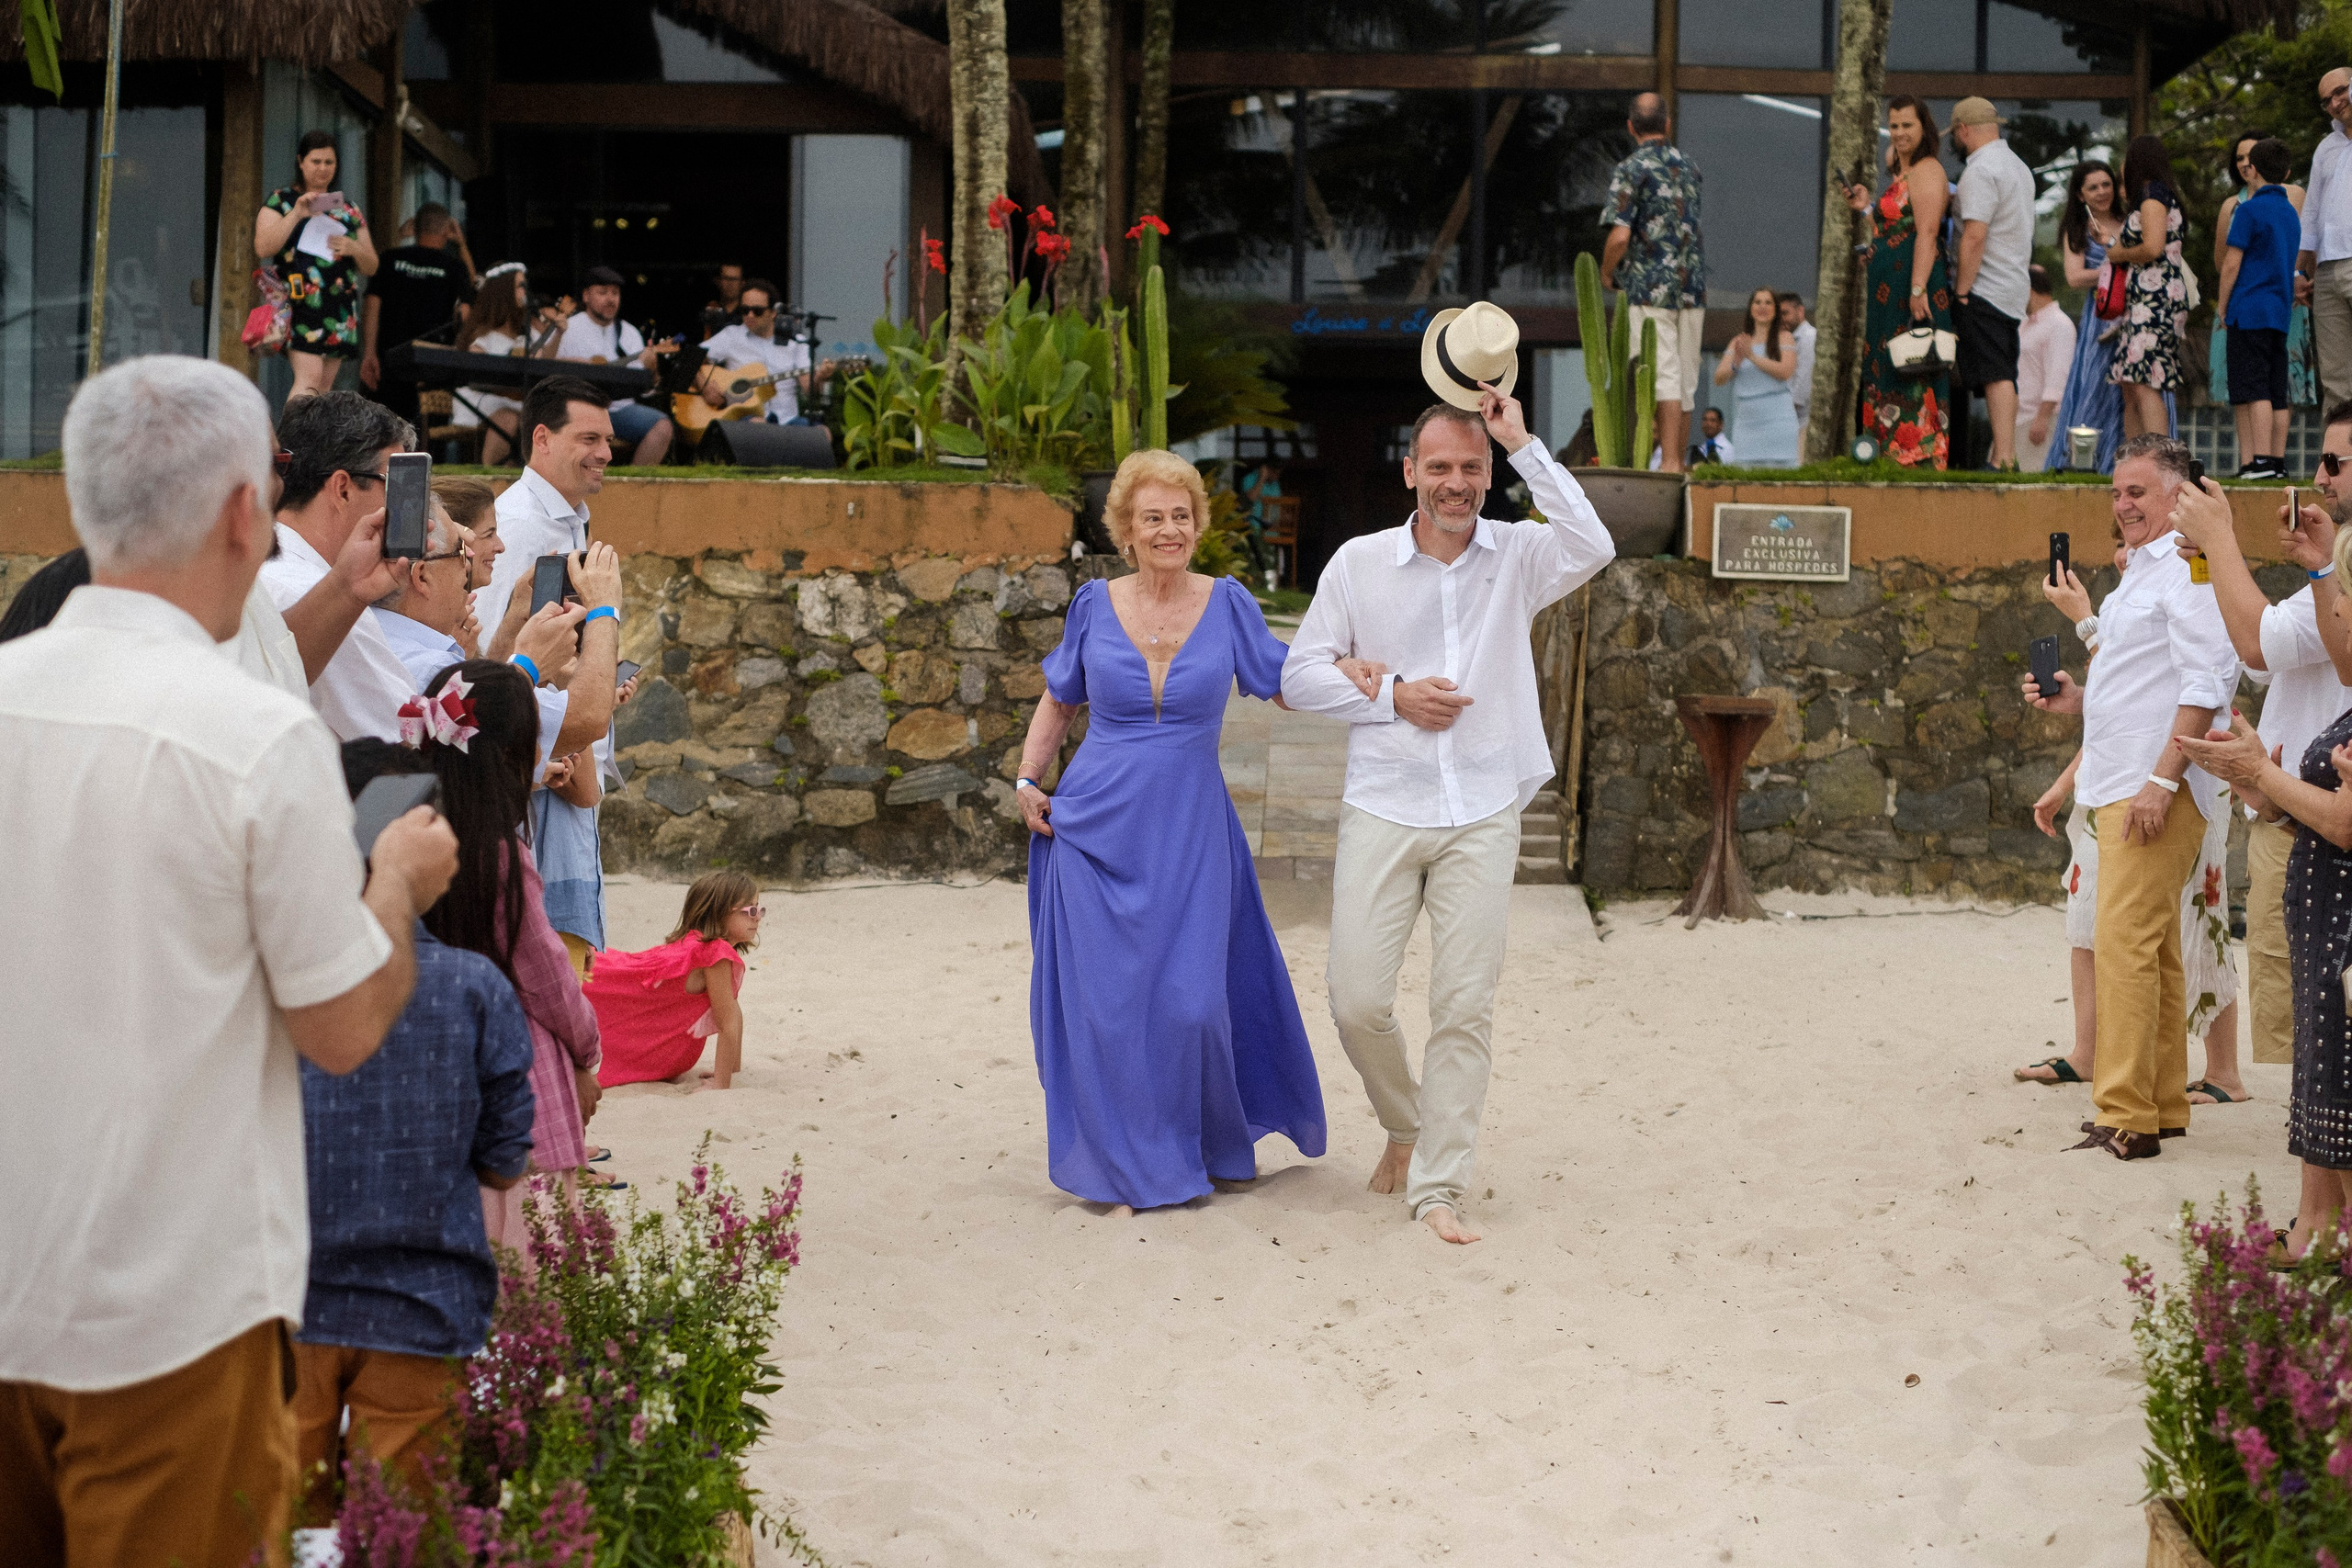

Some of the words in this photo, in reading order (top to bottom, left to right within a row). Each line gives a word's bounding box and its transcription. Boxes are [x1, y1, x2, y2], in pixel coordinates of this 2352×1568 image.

[1751, 536, 1814, 548] ENTRADA
[1744, 547, 1820, 561] EXCLUSIVA
[1724, 559, 1761, 570] PARA
